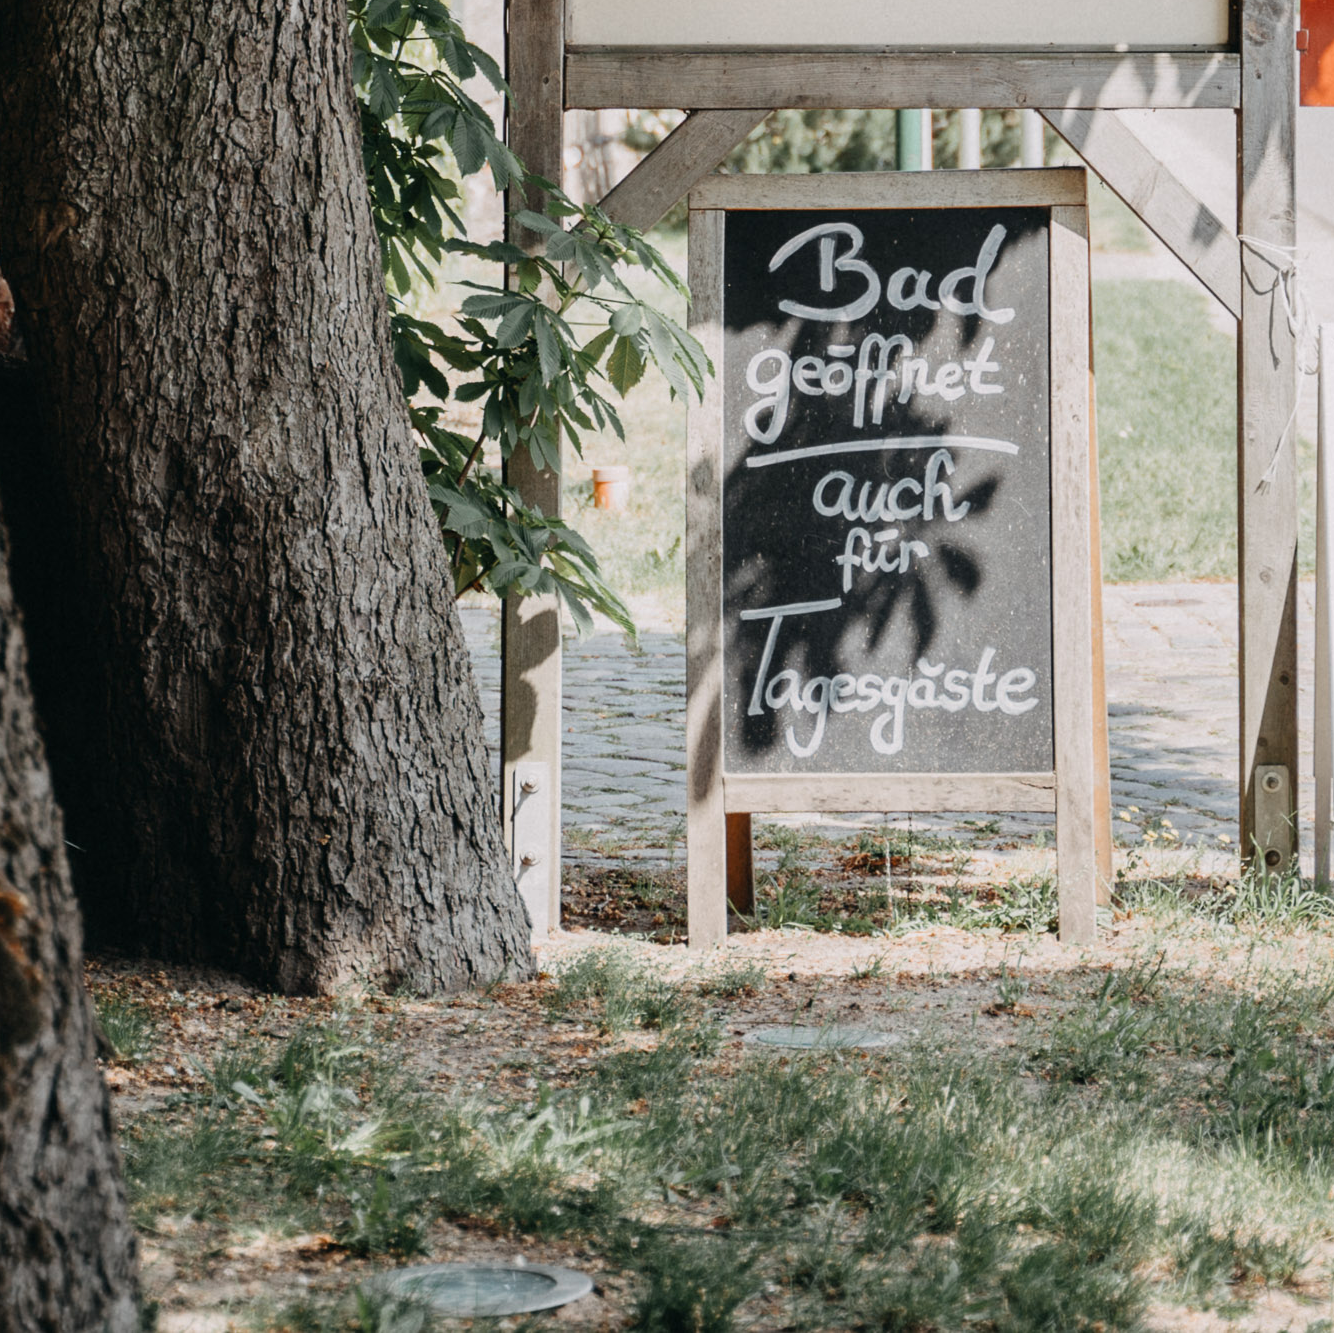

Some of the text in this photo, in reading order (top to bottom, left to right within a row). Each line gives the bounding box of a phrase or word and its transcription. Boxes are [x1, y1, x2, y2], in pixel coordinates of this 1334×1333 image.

[768, 221, 1016, 325] Bad
[742, 332, 1005, 445] geöffnet
[812, 447, 971, 523] auch
[835, 527, 929, 594] für
[739, 597, 1040, 758] Tagesgäste
